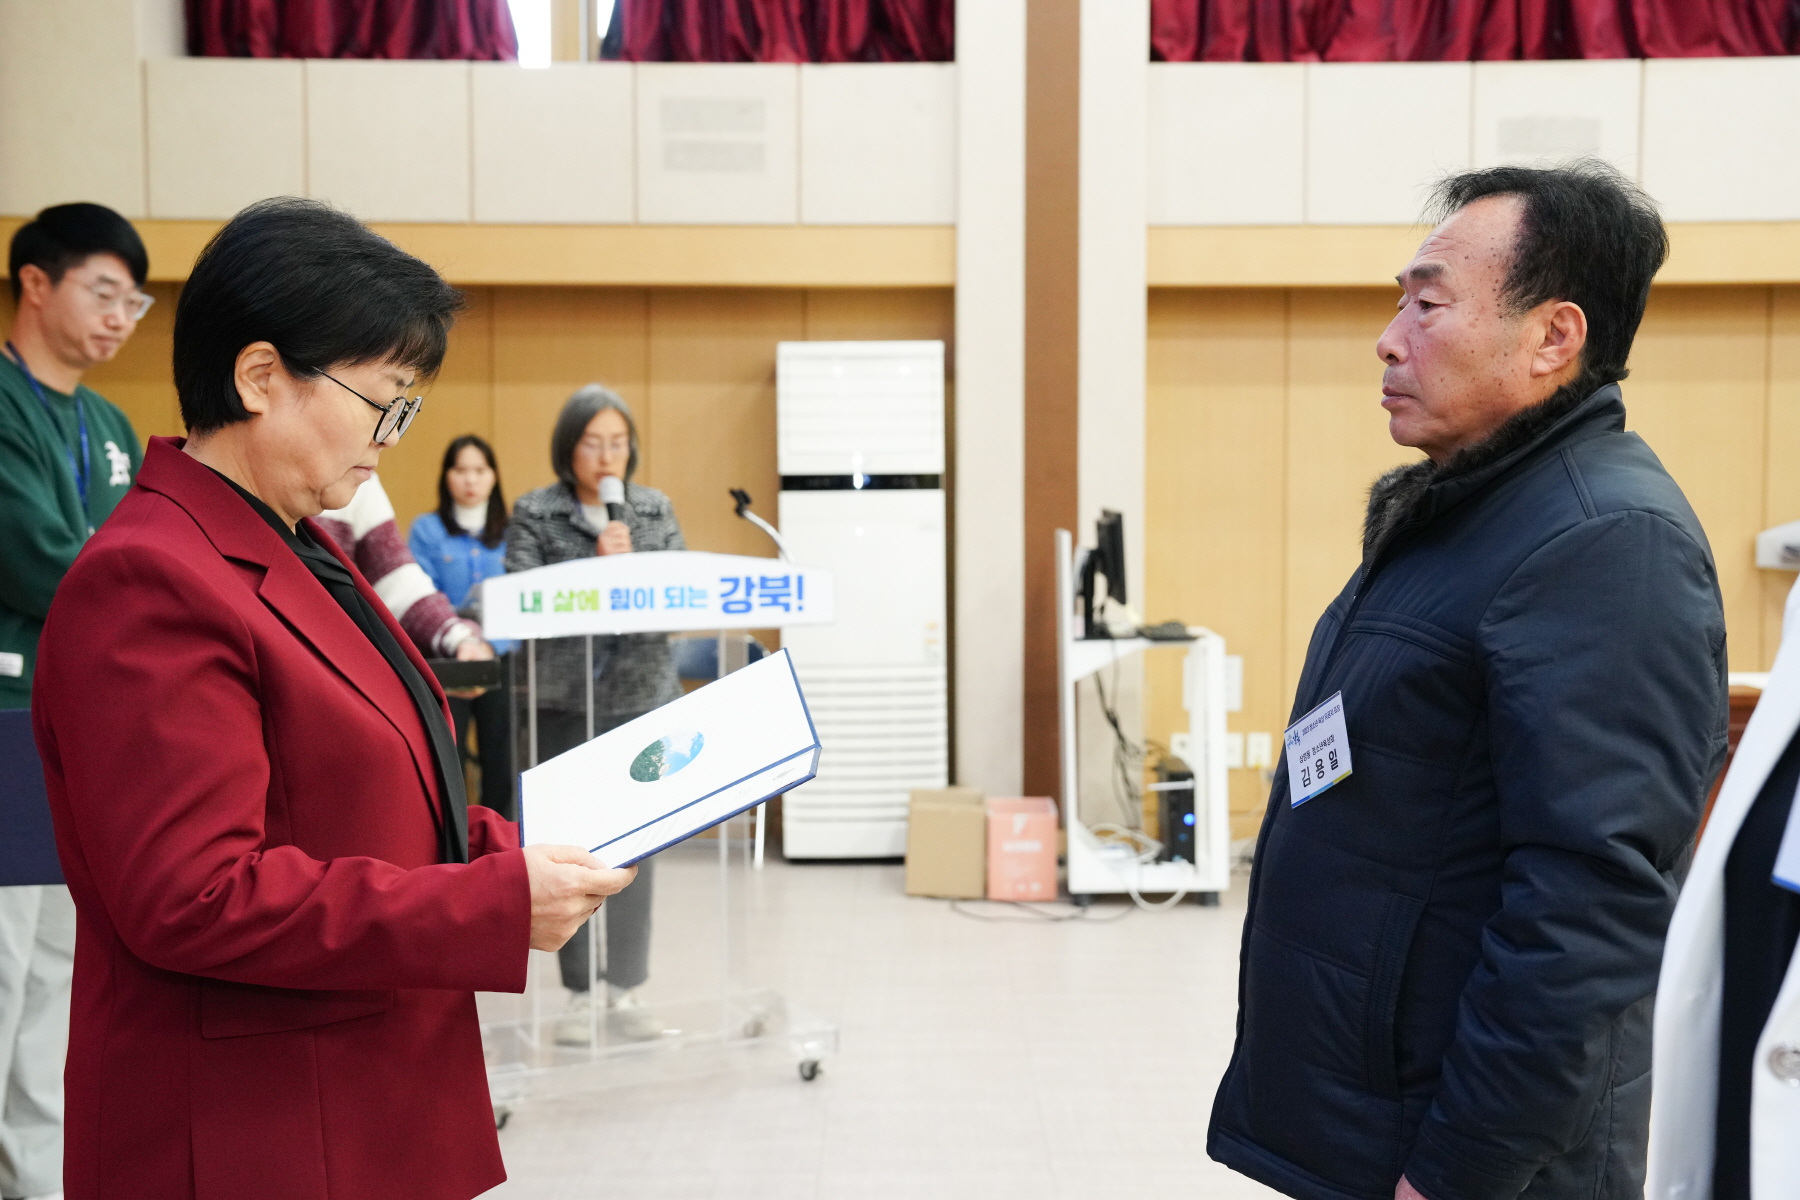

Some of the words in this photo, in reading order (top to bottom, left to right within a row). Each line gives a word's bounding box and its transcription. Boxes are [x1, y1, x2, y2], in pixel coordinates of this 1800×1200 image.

[520, 590, 543, 613] 내
[610, 587, 655, 610] 힘이
[664, 586, 707, 609] 되는
[719, 575, 804, 614] 강북!
